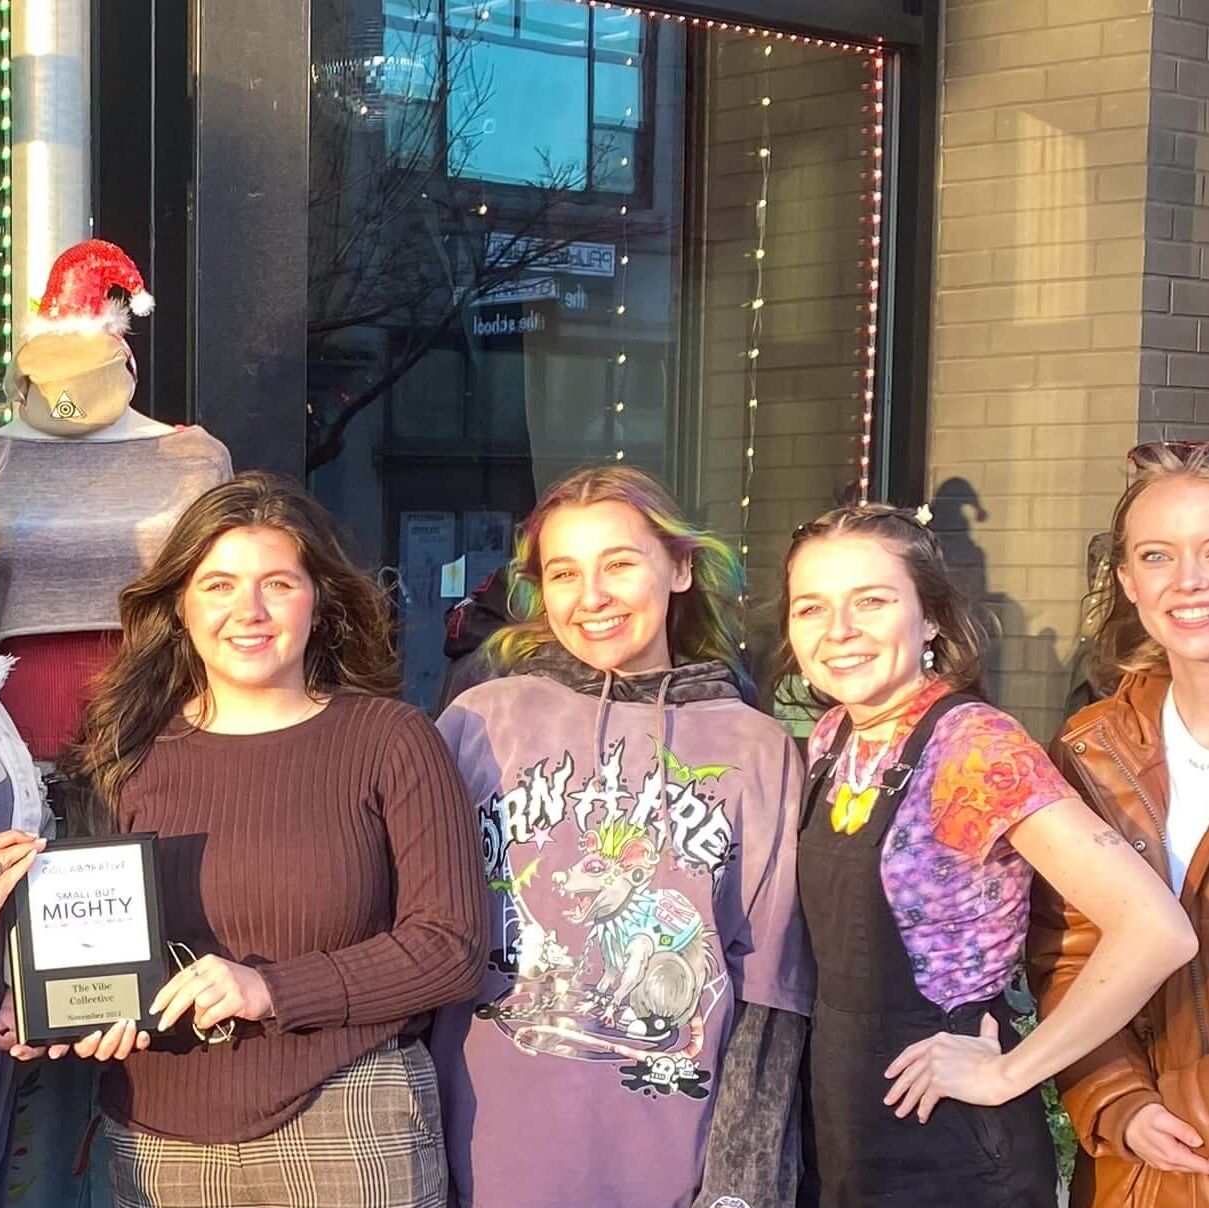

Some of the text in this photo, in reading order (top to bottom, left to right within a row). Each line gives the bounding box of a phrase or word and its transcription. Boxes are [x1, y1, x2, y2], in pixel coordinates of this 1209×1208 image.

[56, 887, 116, 901] SMALL BUT
[43, 897, 132, 921] MIGHTY
[72, 982, 112, 993] The Vibe
[70, 994, 114, 1006] Collective
